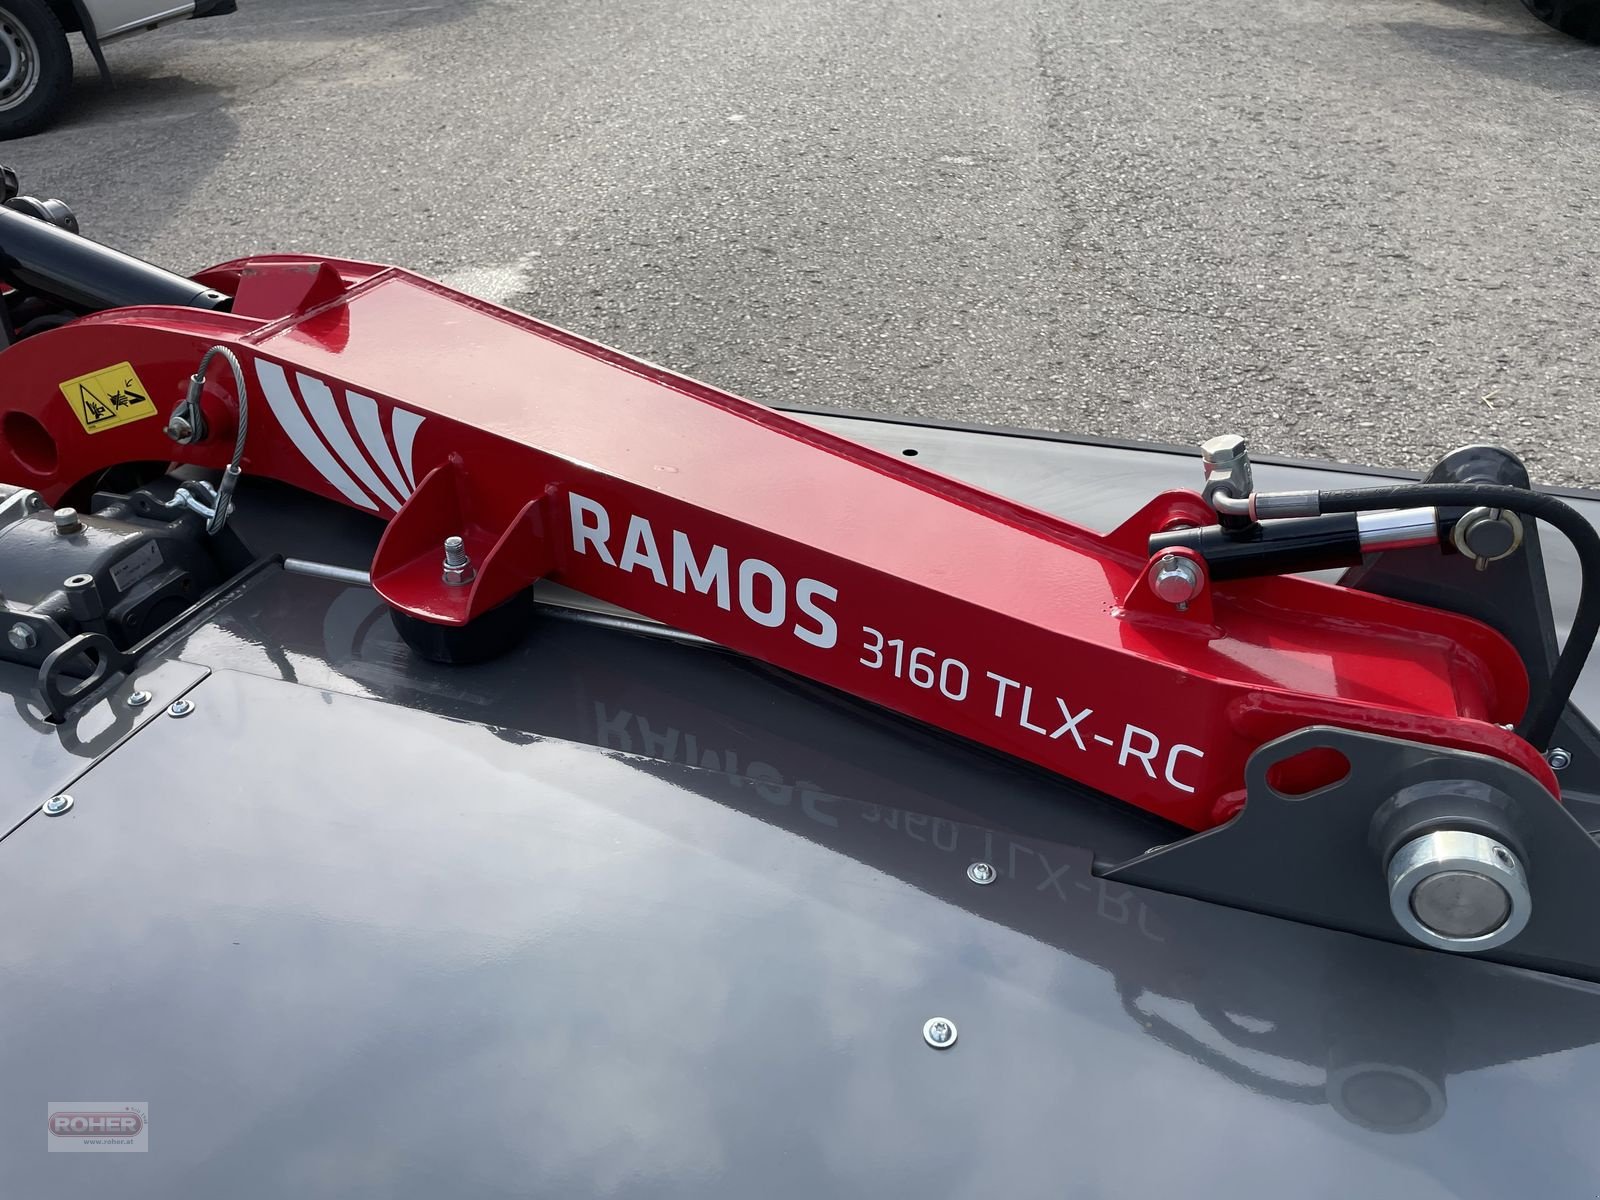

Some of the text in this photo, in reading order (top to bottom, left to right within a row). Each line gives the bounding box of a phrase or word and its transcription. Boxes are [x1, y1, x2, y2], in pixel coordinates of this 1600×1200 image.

[568, 491, 1205, 793] RAMOS 3160 TLX-RC
